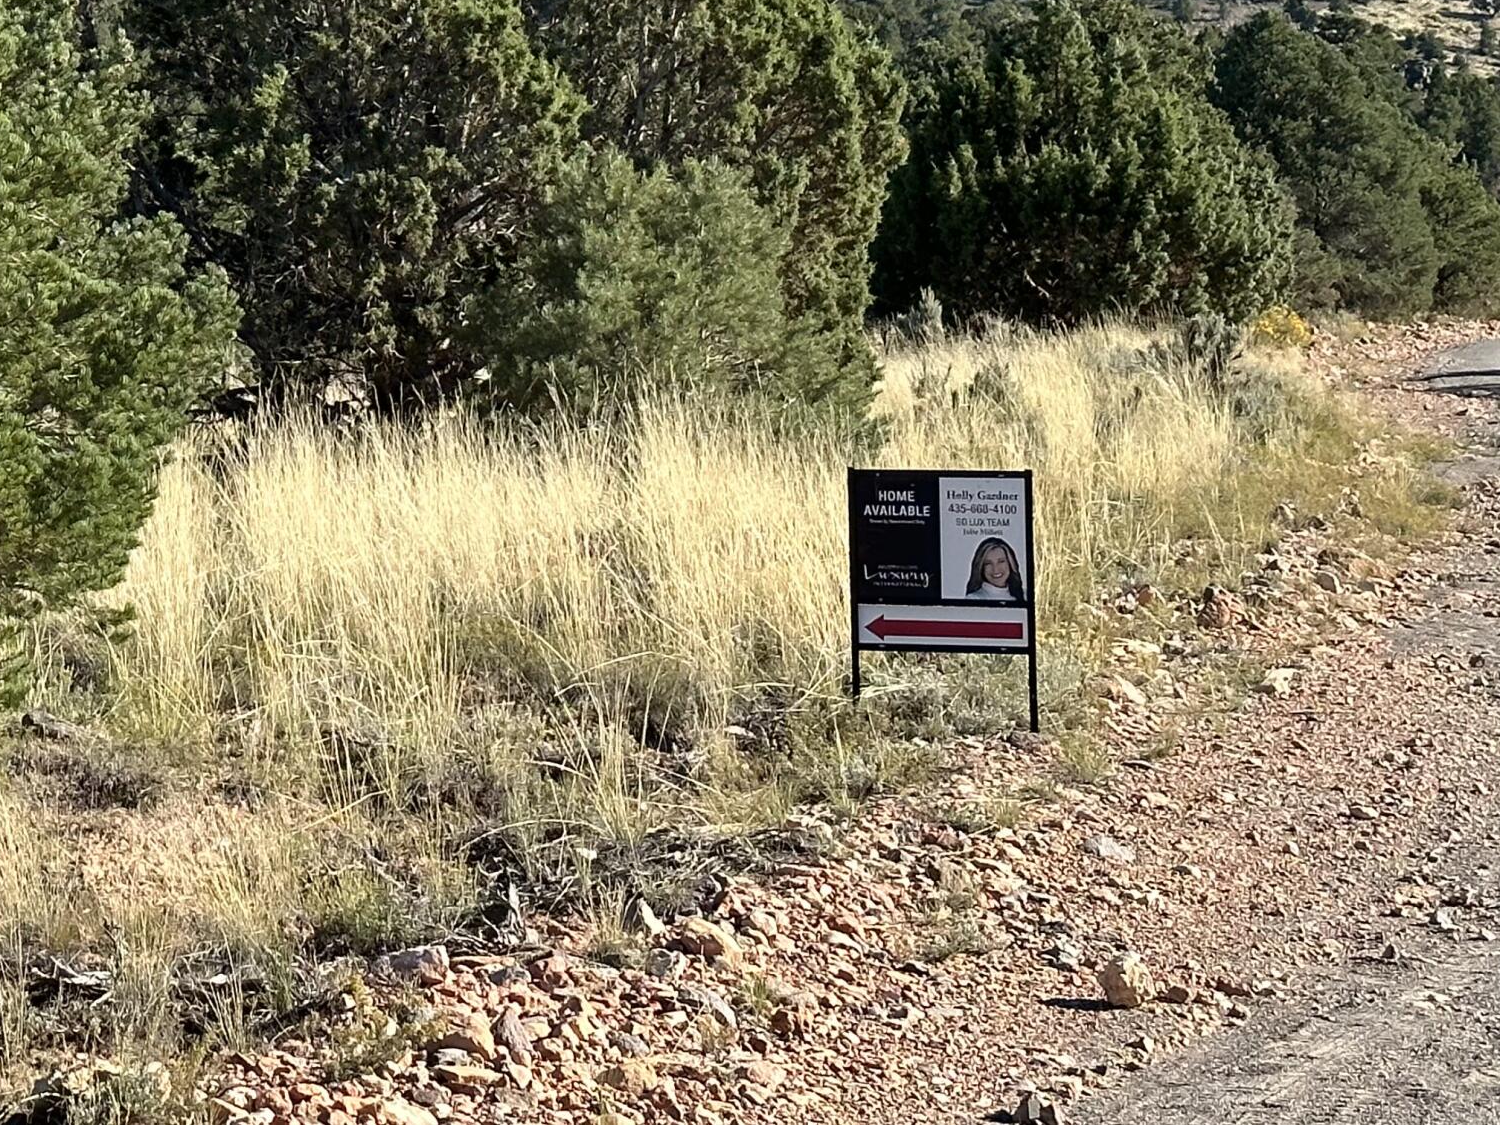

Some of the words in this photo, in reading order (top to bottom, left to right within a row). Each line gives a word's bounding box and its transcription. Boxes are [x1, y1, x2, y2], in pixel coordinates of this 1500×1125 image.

[878, 490, 915, 502] HOME
[947, 490, 973, 502] Holly
[977, 490, 1019, 501] Gardner
[863, 505, 930, 517] AVAILABLE
[987, 518, 1010, 527] TEAM
